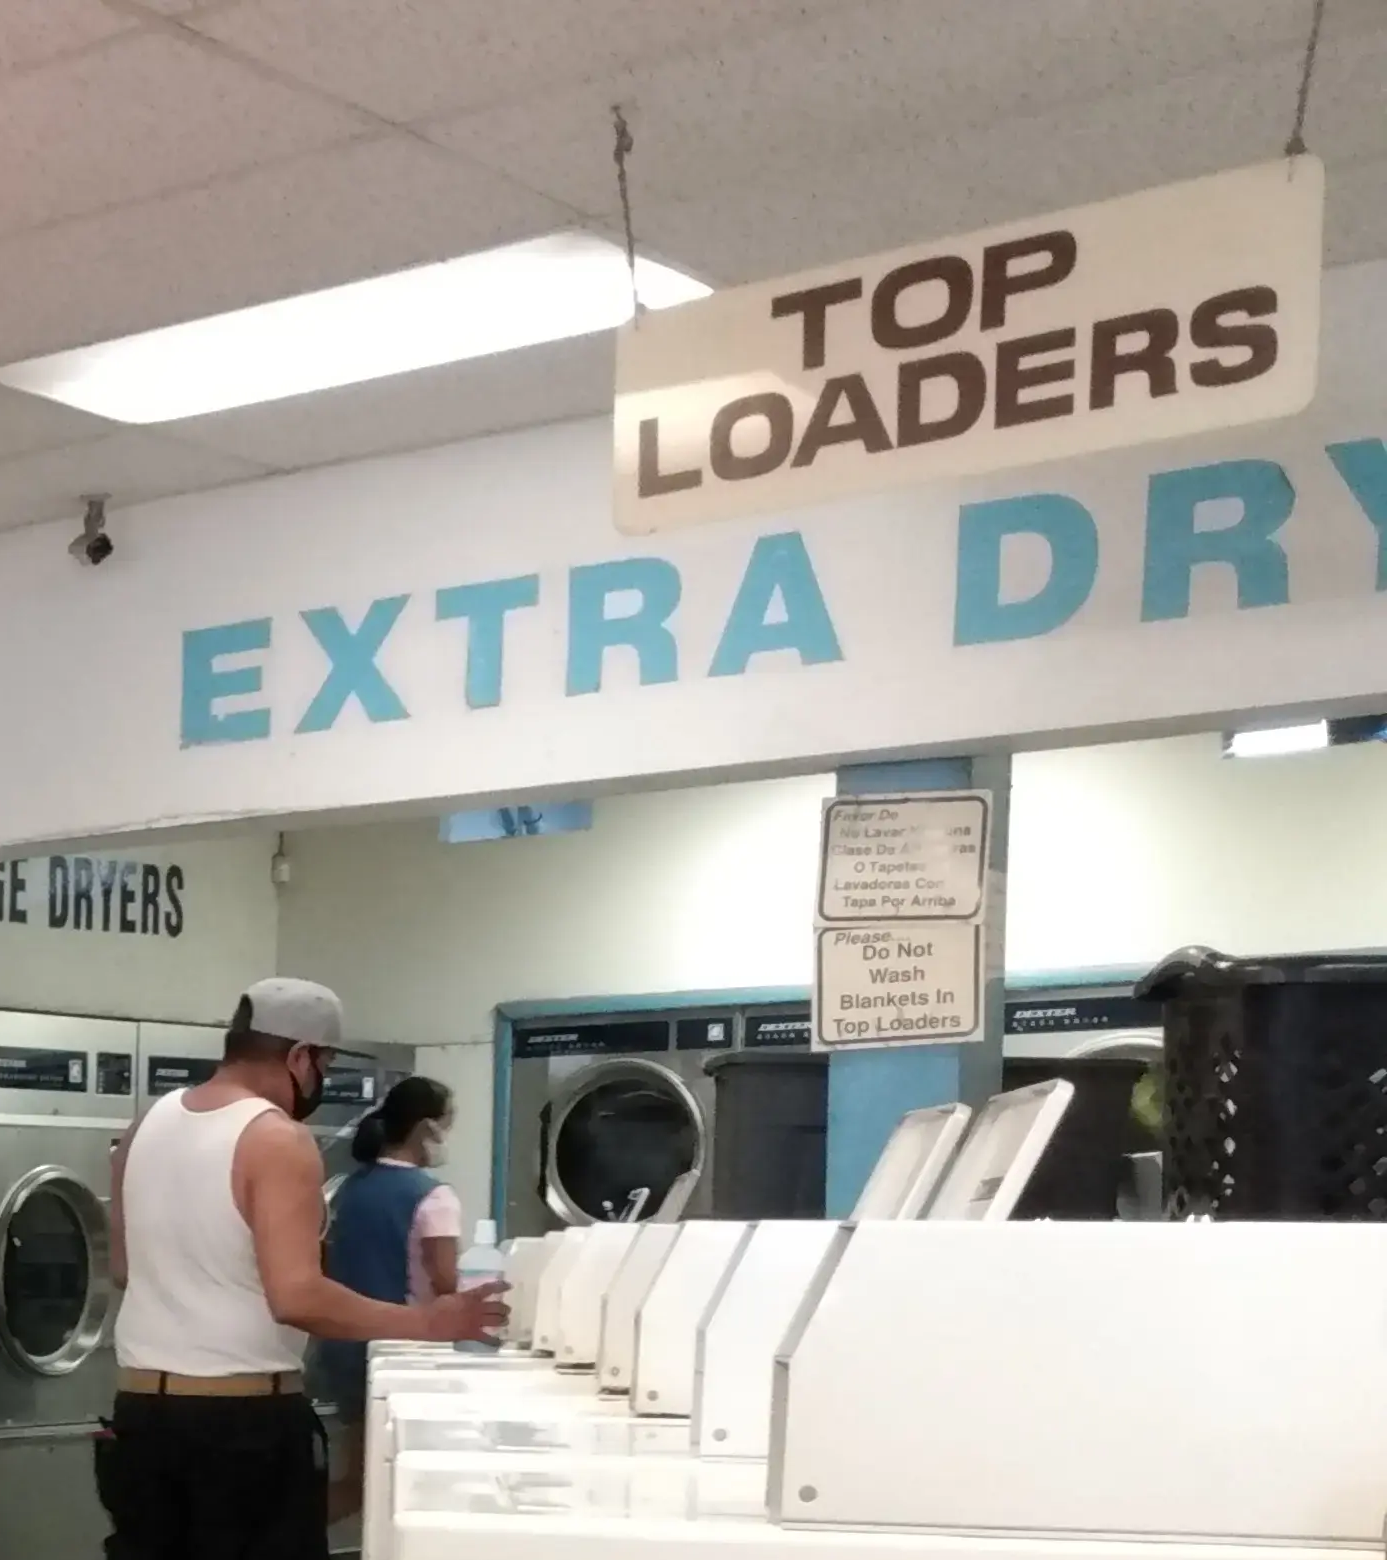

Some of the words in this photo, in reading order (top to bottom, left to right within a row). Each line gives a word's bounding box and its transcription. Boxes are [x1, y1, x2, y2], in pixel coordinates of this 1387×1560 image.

[770, 229, 1077, 371] TOP
[637, 284, 1278, 498] LOADERS
[178, 529, 845, 752] EXTRA
[853, 861, 866, 874] O
[48, 855, 184, 938] DRYERS
[843, 896, 876, 909] Tapa
[881, 895, 906, 908] Por
[910, 894, 956, 907] Arriba
[862, 945, 890, 961] Do
[897, 942, 933, 958] Not
[869, 965, 925, 984] Wash
[840, 991, 929, 1010] Blankets
[936, 988, 955, 1004] In
[832, 1018, 870, 1037] Top
[876, 1013, 961, 1032] Loaders
